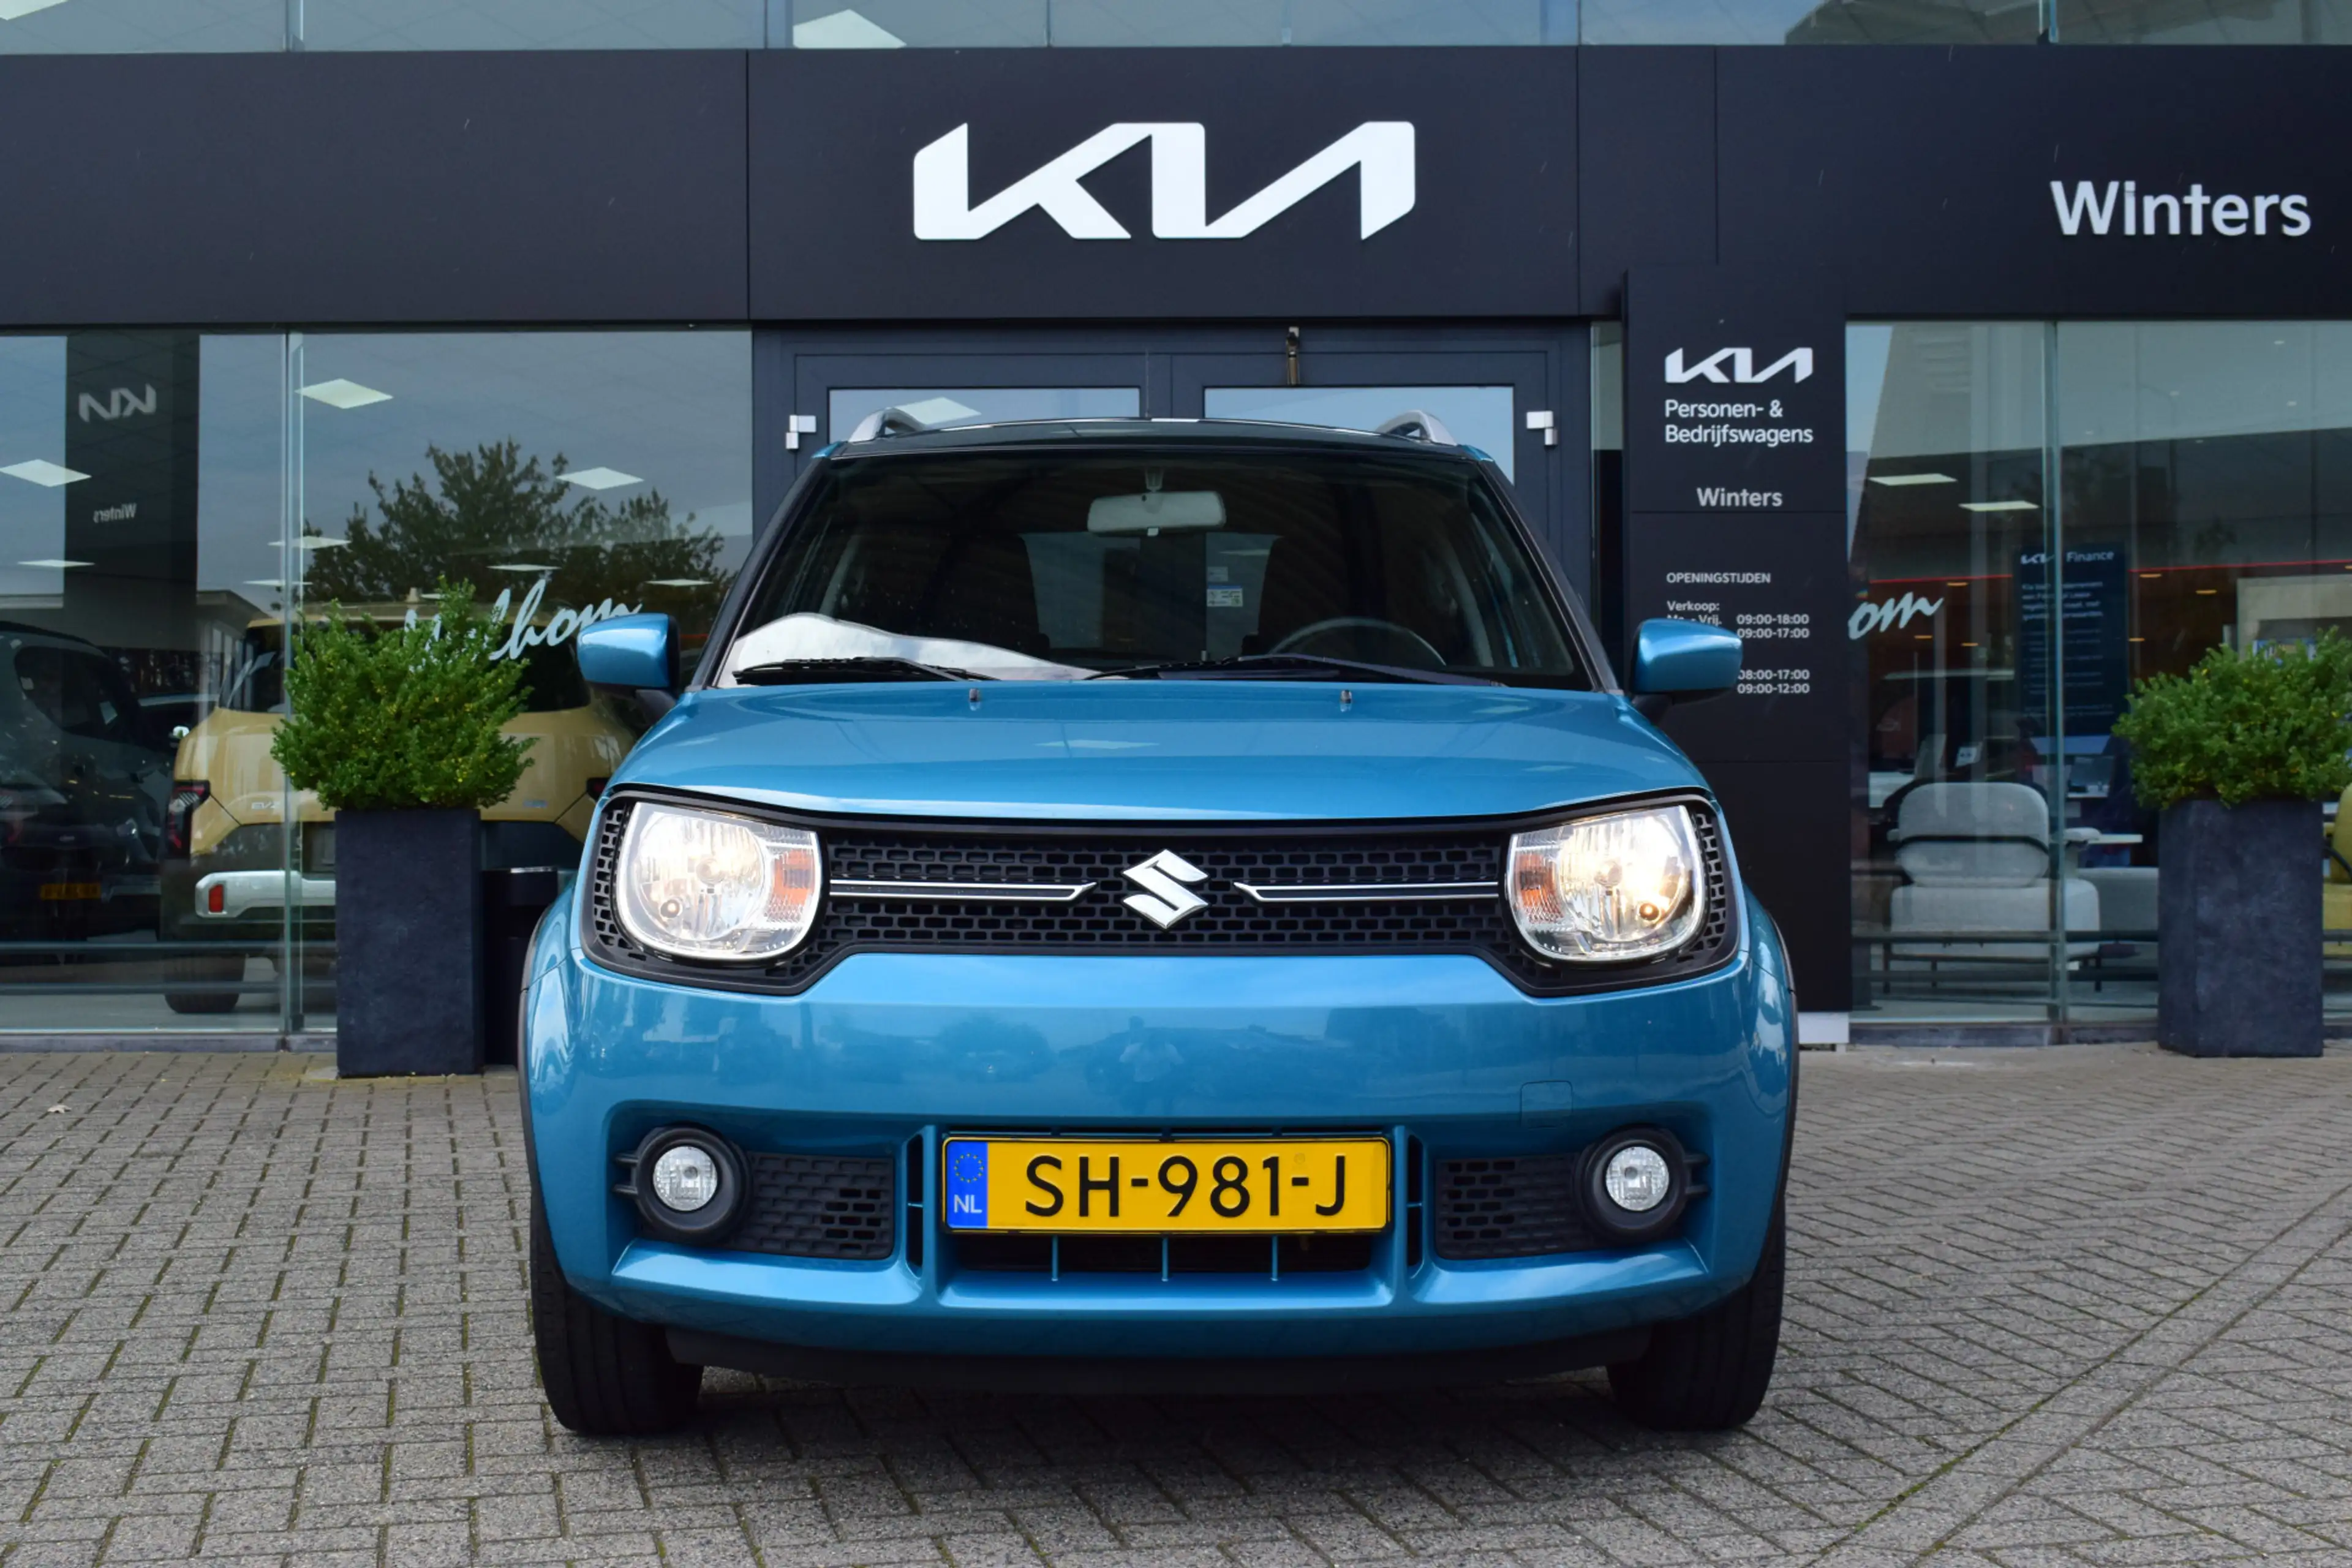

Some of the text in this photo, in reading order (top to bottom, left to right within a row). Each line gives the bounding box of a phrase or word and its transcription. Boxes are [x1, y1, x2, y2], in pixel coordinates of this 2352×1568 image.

[913, 121, 1415, 240] KIA
[2050, 181, 2312, 236] Winters
[1665, 347, 1813, 383] KIA
[1665, 399, 1784, 418] Personen- &
[1665, 424, 1814, 447] Bedrijfswagens
[1697, 488, 1783, 507] Winters
[2067, 552, 2114, 562] Finance
[1666, 572, 1771, 584] OPENINGSTIJDEN
[1667, 601, 1720, 613] Verkoop:
[1736, 614, 1809, 625] 09:00-18:00
[1737, 627, 1810, 639] 09:00-17:00
[1738, 669, 1810, 680] 08:00-17:00
[1737, 683, 1810, 694] 09:00-12:00
[954, 1155, 1346, 1217] NL SH-981-J
